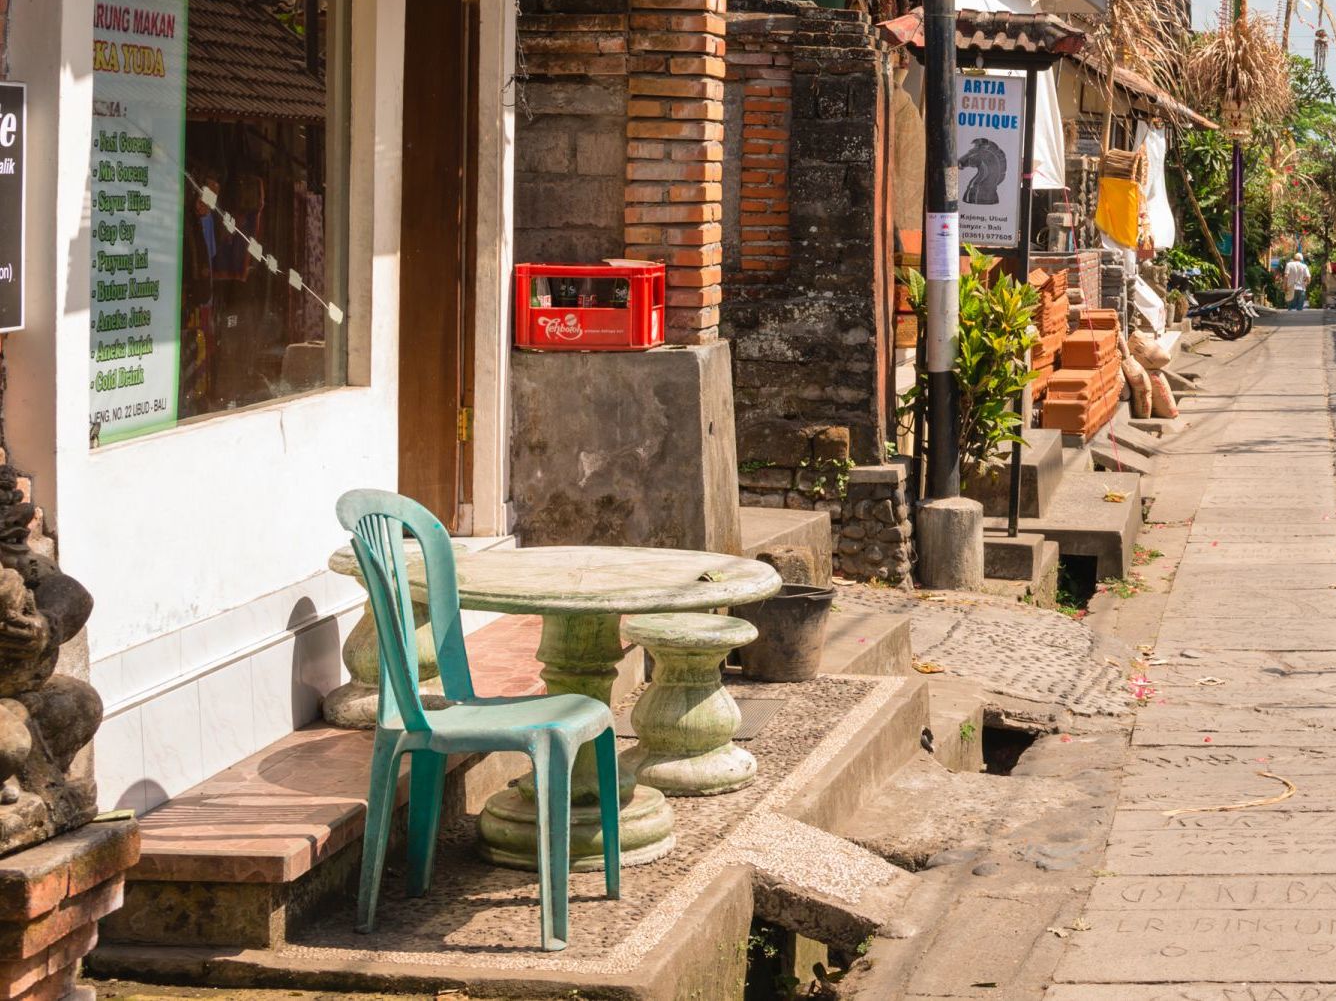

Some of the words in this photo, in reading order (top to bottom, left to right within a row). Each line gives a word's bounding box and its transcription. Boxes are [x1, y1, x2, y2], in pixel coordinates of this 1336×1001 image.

[133, 8, 175, 39] MAKAN
[93, 39, 120, 73] KA
[121, 43, 165, 78] YUDA
[964, 79, 1005, 95] ARTJA
[962, 95, 1006, 111] CATUR
[0, 105, 16, 147] e
[958, 111, 1018, 129] OUTIQUE
[99, 130, 117, 152] Nasi
[119, 131, 152, 158] Goreng
[99, 160, 115, 182] Mie
[117, 161, 149, 187] Goreng
[98, 190, 126, 216] Sayur
[127, 190, 151, 216] Hijau
[98, 220, 117, 245] Cap
[119, 220, 136, 245] Cay
[97, 250, 134, 275] Puyung
[97, 280, 128, 302] Bubur
[128, 277, 159, 301] Kuning
[97, 309, 127, 332] Aneka
[128, 307, 151, 328] Juice
[96, 338, 126, 362] Aneka
[127, 334, 153, 360] Rujak
[95, 369, 117, 392] Cold
[118, 365, 144, 388] Drink
[133, 401, 150, 416] UBUD
[154, 398, 166, 412] BALI
